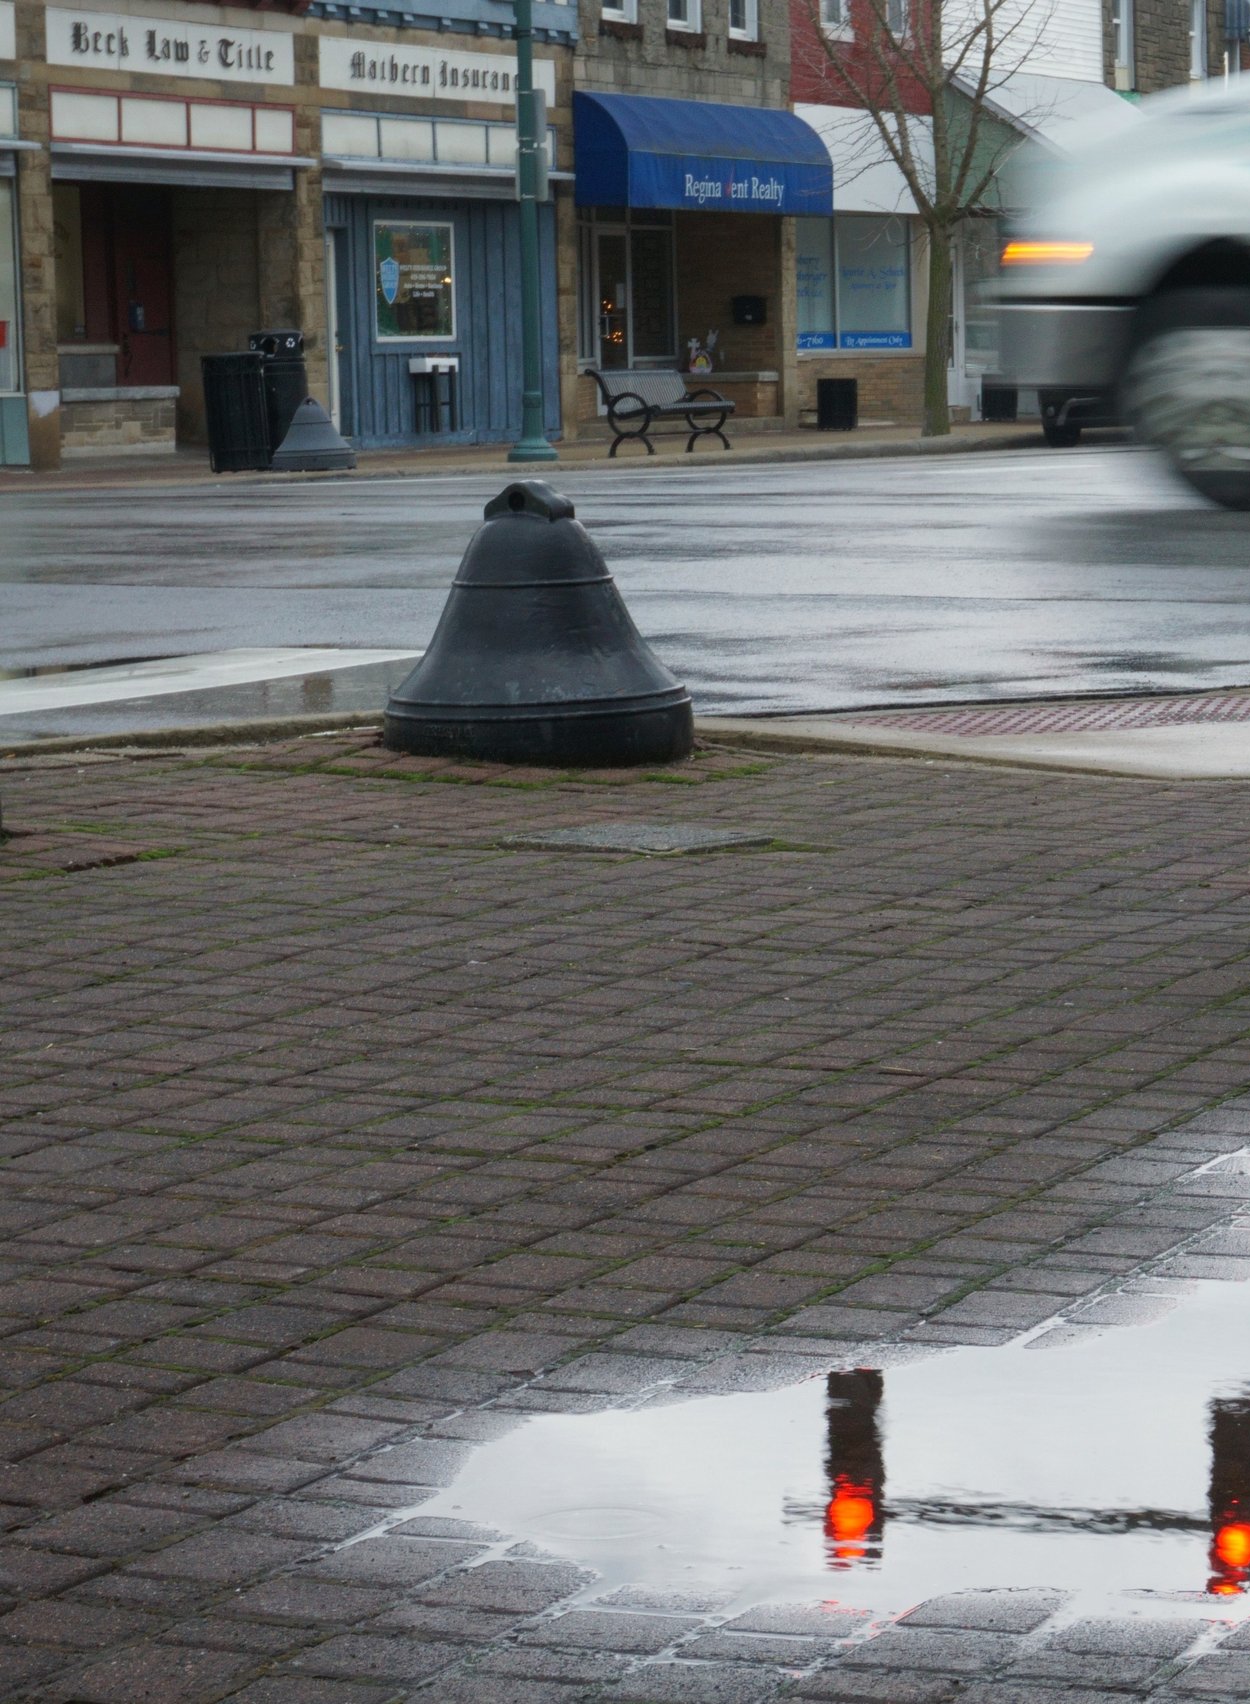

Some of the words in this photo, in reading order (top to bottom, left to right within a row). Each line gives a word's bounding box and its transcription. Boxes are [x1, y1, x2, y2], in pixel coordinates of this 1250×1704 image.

[71, 21, 129, 57] Beck
[146, 29, 190, 62] Law
[198, 39, 210, 63] &
[218, 38, 275, 71] Title
[439, 60, 519, 92] Insuranc
[684, 173, 721, 204] Regina
[751, 176, 784, 206] Realty
